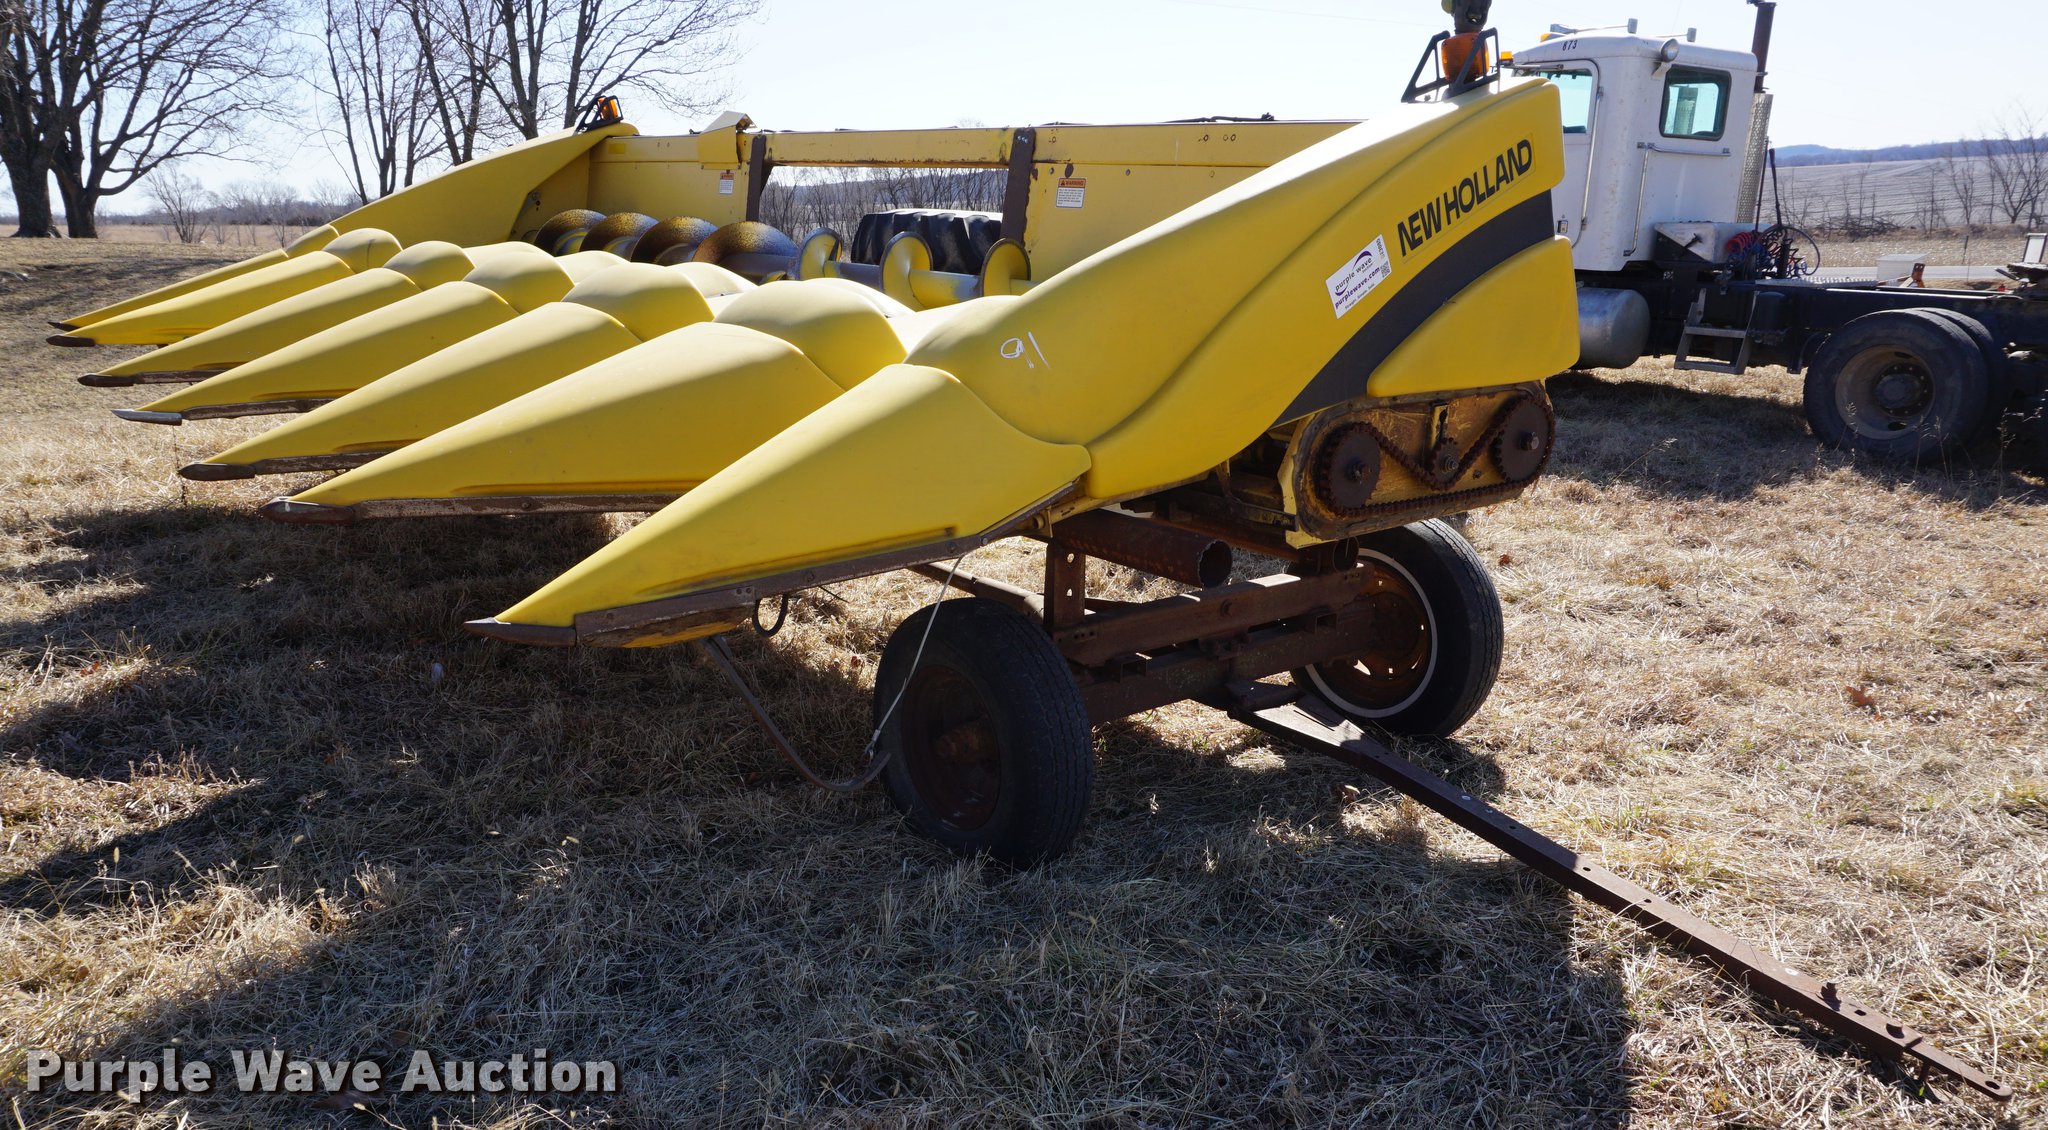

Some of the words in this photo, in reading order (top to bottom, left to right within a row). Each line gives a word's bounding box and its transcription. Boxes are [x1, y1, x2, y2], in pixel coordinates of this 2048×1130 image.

[1562, 40, 1577, 51] 873
[1397, 197, 1442, 257] NEW
[1443, 139, 1533, 226] HOLLAND
[1334, 266, 1381, 309] purplewave.com
[1335, 271, 1356, 292] purple
[1355, 257, 1373, 273] wave
